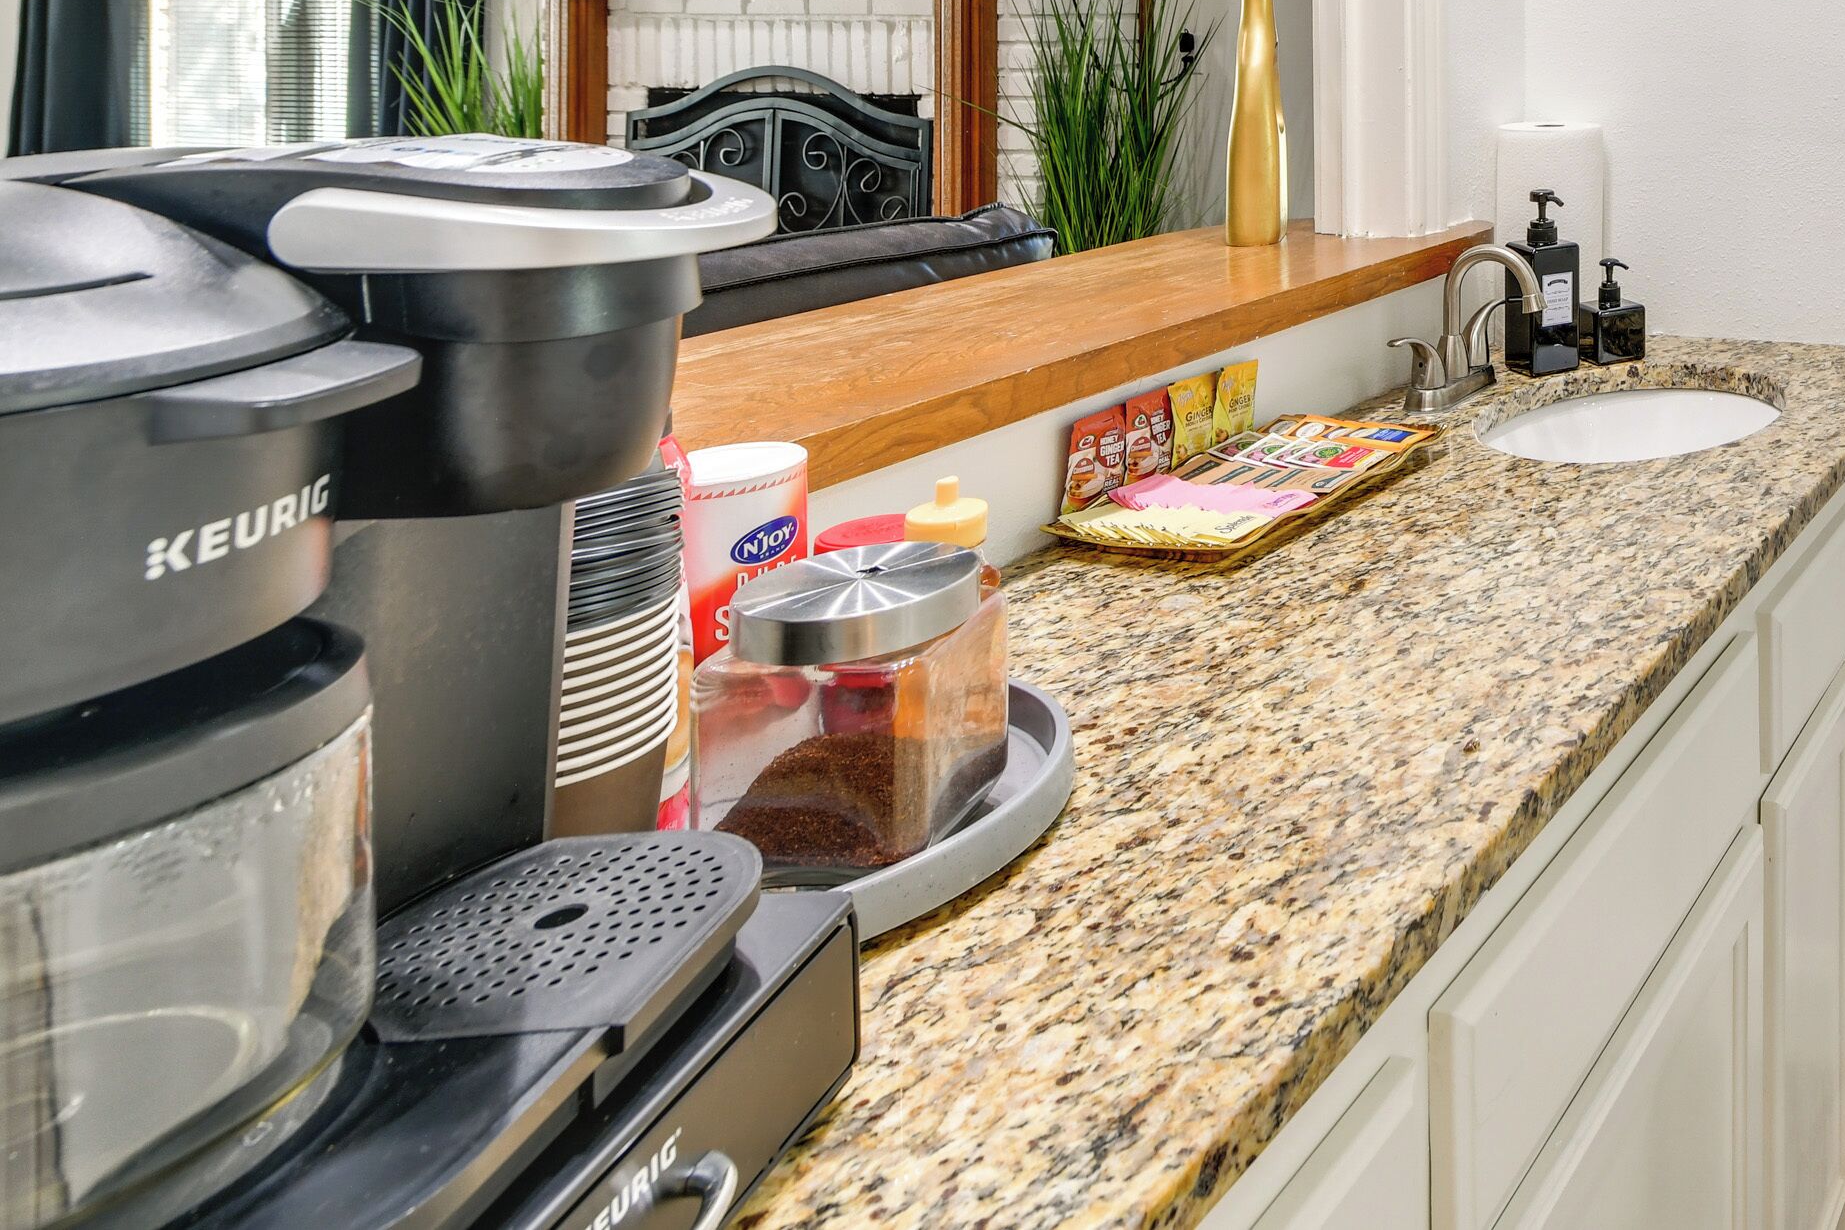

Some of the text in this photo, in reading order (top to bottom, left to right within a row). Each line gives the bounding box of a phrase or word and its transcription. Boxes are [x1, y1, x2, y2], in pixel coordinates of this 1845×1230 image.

[1105, 452, 1120, 466] TEA
[144, 473, 330, 580] KEURIG
[585, 1133, 678, 1230] EURIG
